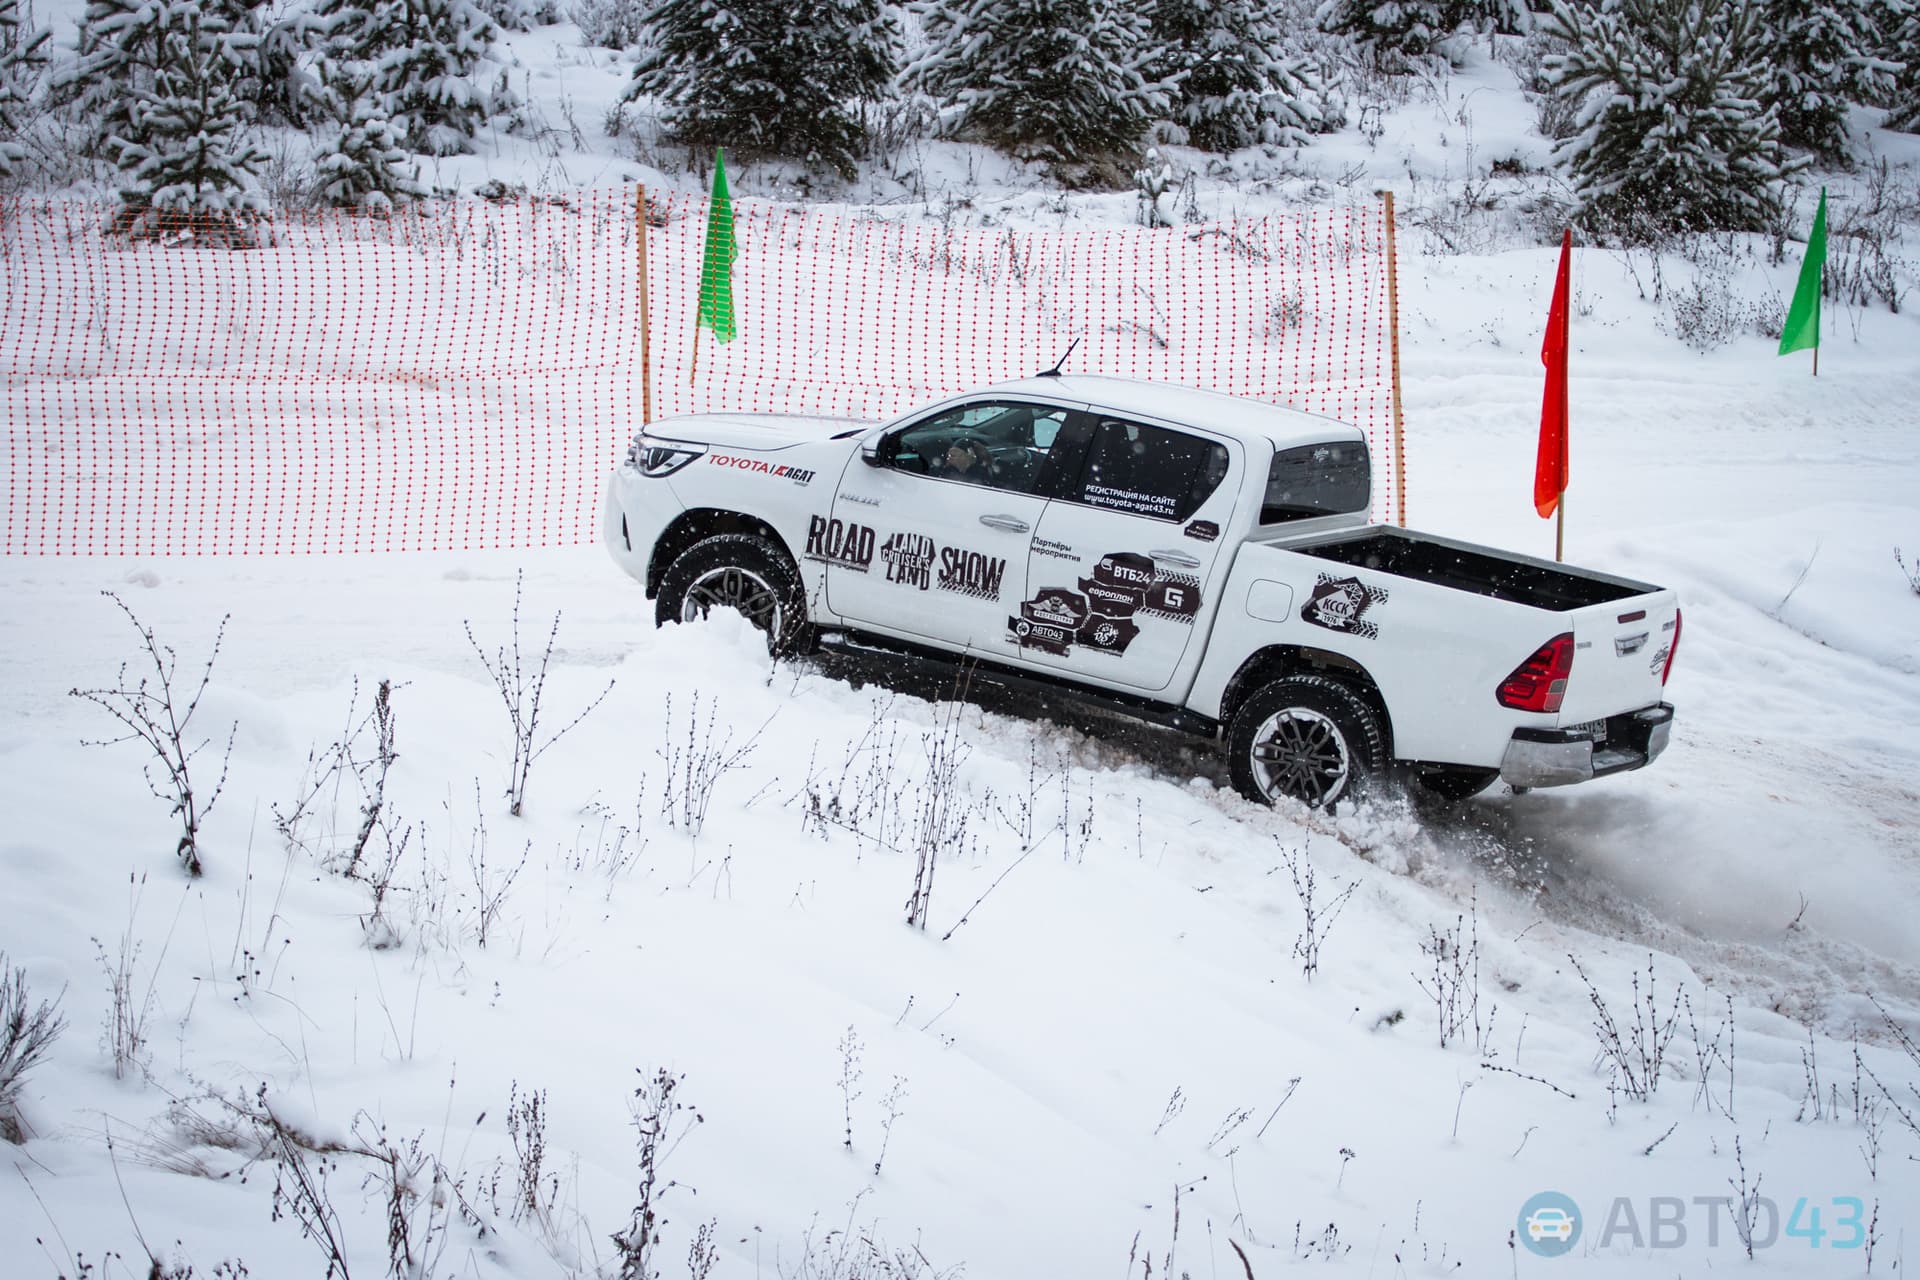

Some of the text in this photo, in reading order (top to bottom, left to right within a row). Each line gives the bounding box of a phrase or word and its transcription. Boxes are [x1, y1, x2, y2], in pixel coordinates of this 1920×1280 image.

[709, 454, 769, 474] TOYOTA
[783, 466, 816, 483] AGAT
[1084, 493, 1174, 515] www.toyota-agat43.ru
[1085, 484, 1176, 506] РЕГИСТРАЦИЯ НА САЙТЕ
[806, 514, 876, 566] ROAD
[892, 532, 932, 559] LAND
[1032, 536, 1072, 552] Партнёры
[882, 549, 930, 571] CRUISER'S
[1031, 546, 1081, 563] мероприятия
[886, 560, 930, 591] LAND
[938, 546, 1007, 594] SHOW
[1113, 566, 1150, 584] ВТБ24
